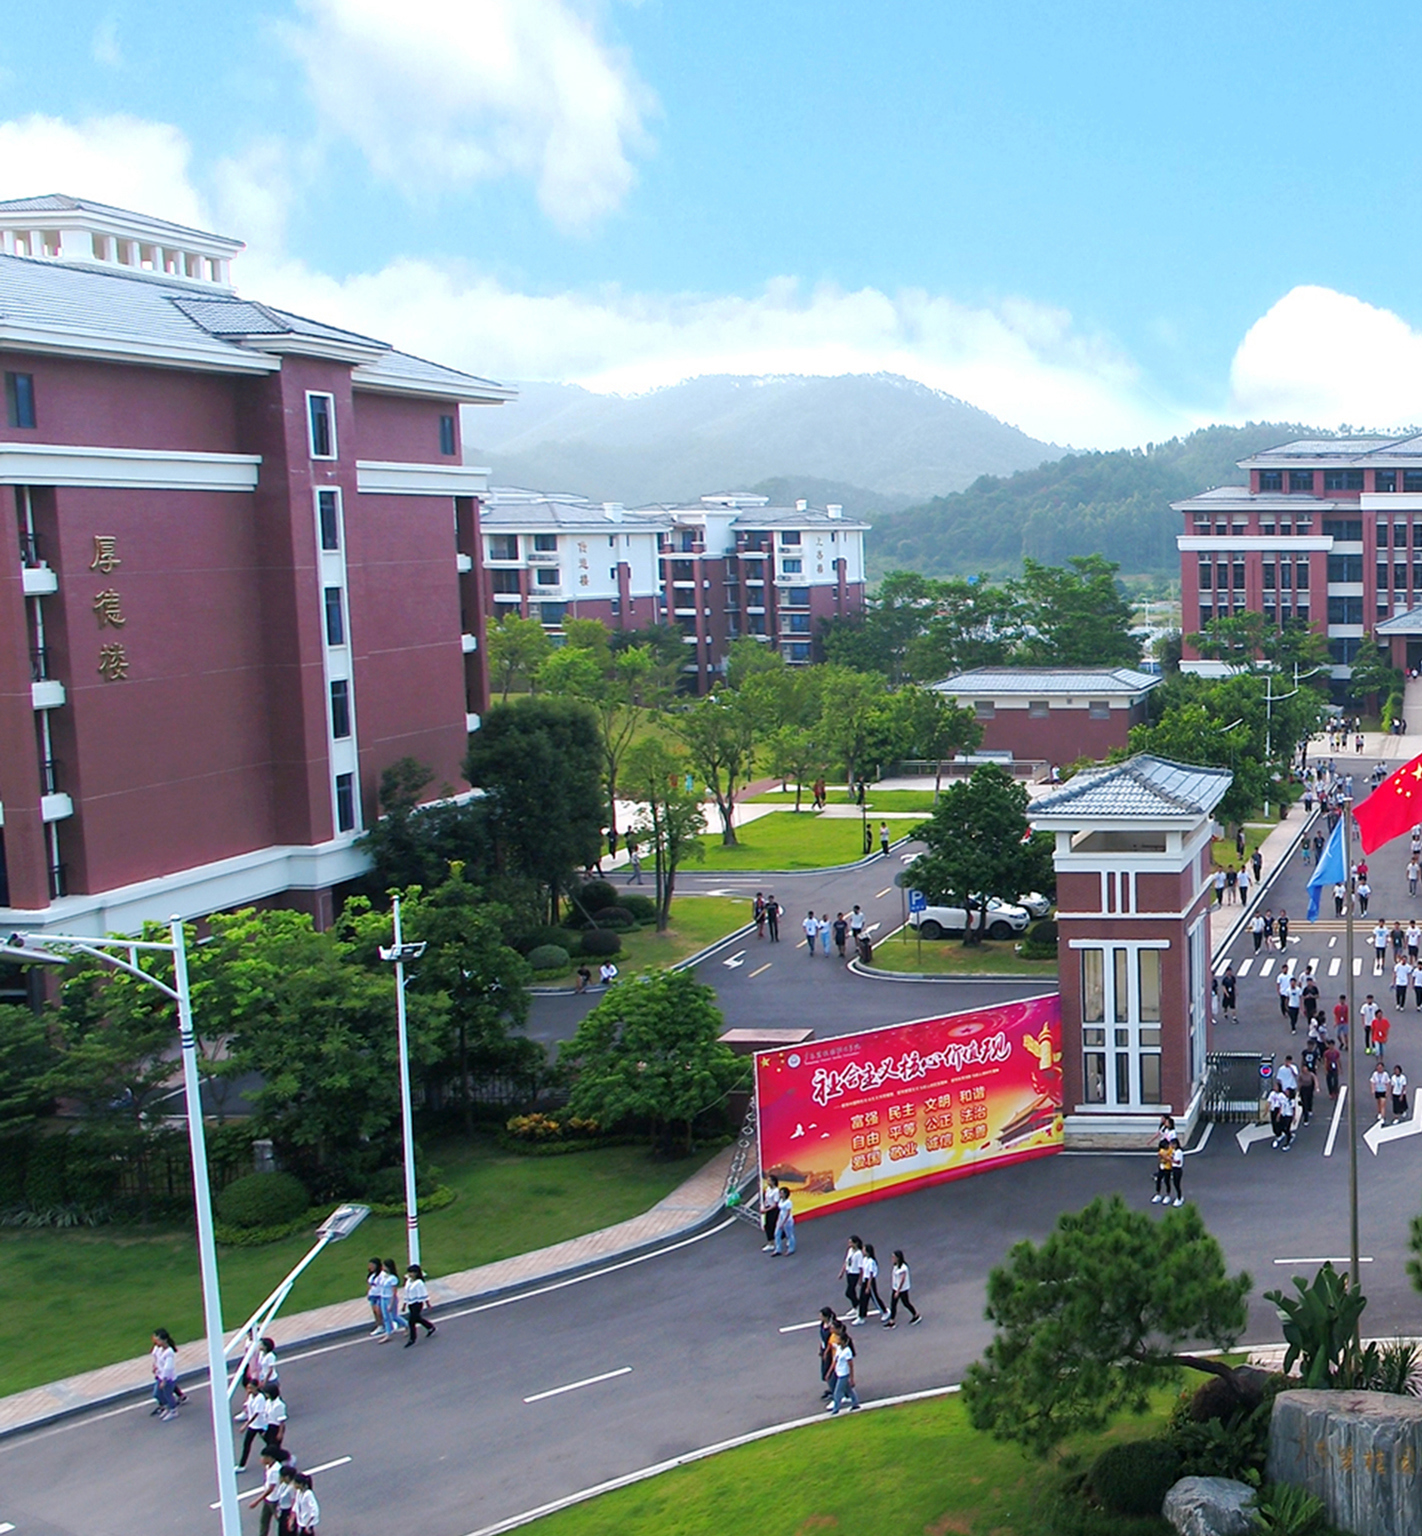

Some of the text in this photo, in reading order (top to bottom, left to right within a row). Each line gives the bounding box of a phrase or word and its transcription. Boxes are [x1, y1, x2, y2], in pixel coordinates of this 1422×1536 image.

[89, 534, 130, 681] 厚德楼
[911, 890, 923, 905] P
[850, 1110, 879, 1130] 富强
[888, 1102, 915, 1121] 民主
[924, 1094, 951, 1112] 文明
[960, 1086, 985, 1104] 和谐
[852, 1105, 987, 1150] 自由 平等 公正 法治
[852, 1150, 881, 1170] 爱国
[889, 1141, 918, 1160] 敬业
[925, 1133, 953, 1151] 诚信
